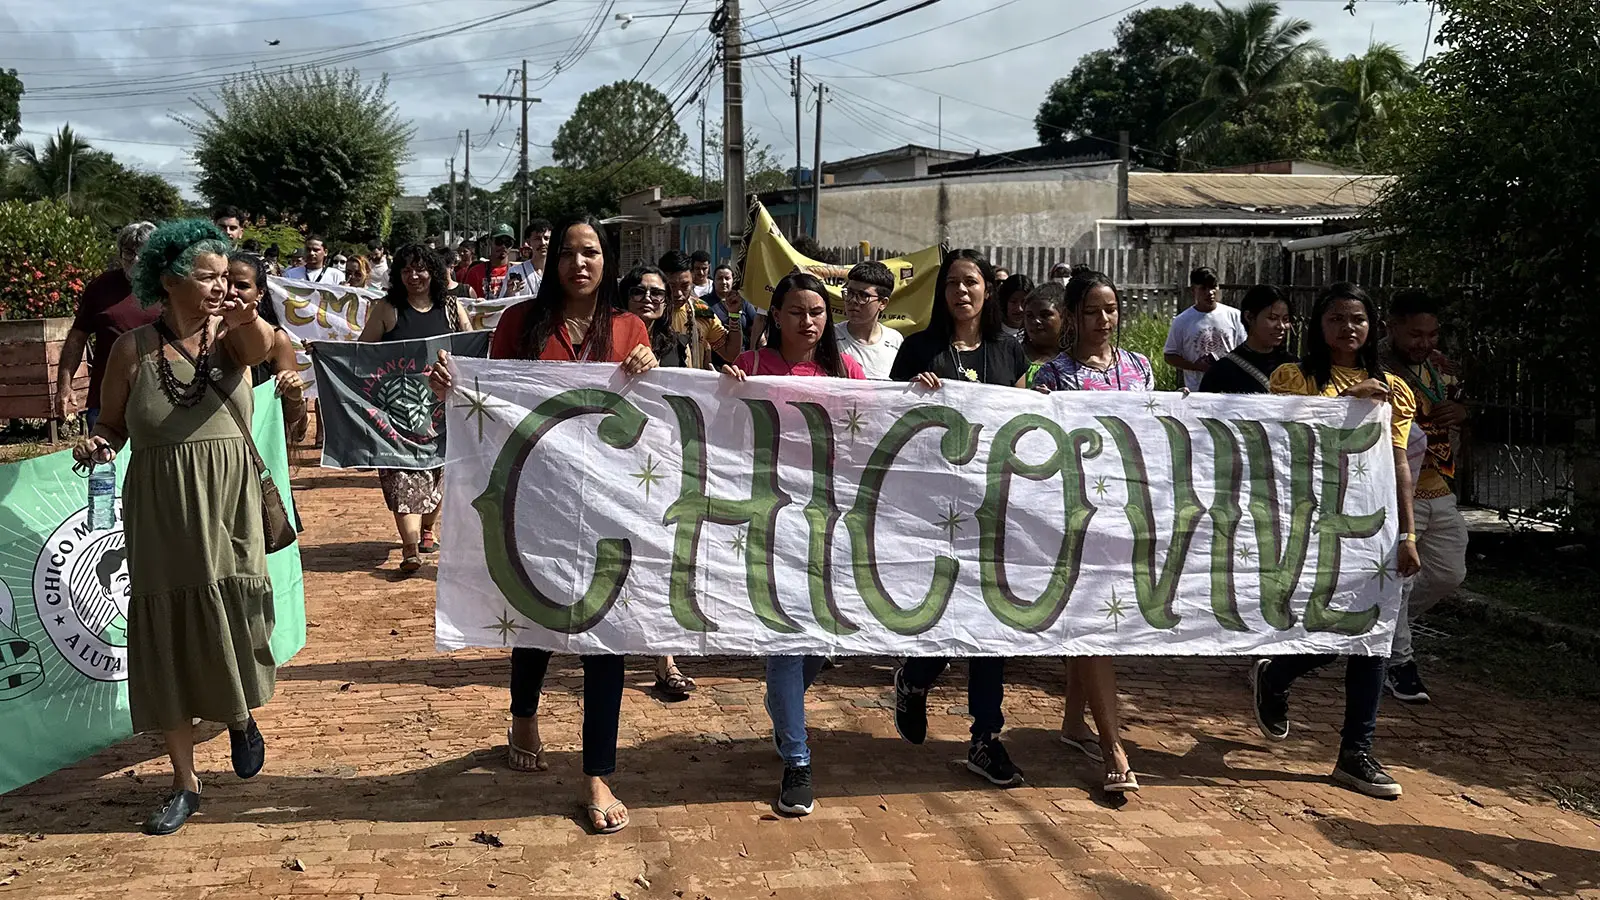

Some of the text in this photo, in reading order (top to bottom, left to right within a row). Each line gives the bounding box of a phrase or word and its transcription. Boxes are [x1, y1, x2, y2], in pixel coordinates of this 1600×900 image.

[470, 387, 1387, 636] CHICO VIVE
[44, 539, 75, 606] CHICO
[64, 633, 121, 672] A LUTA
